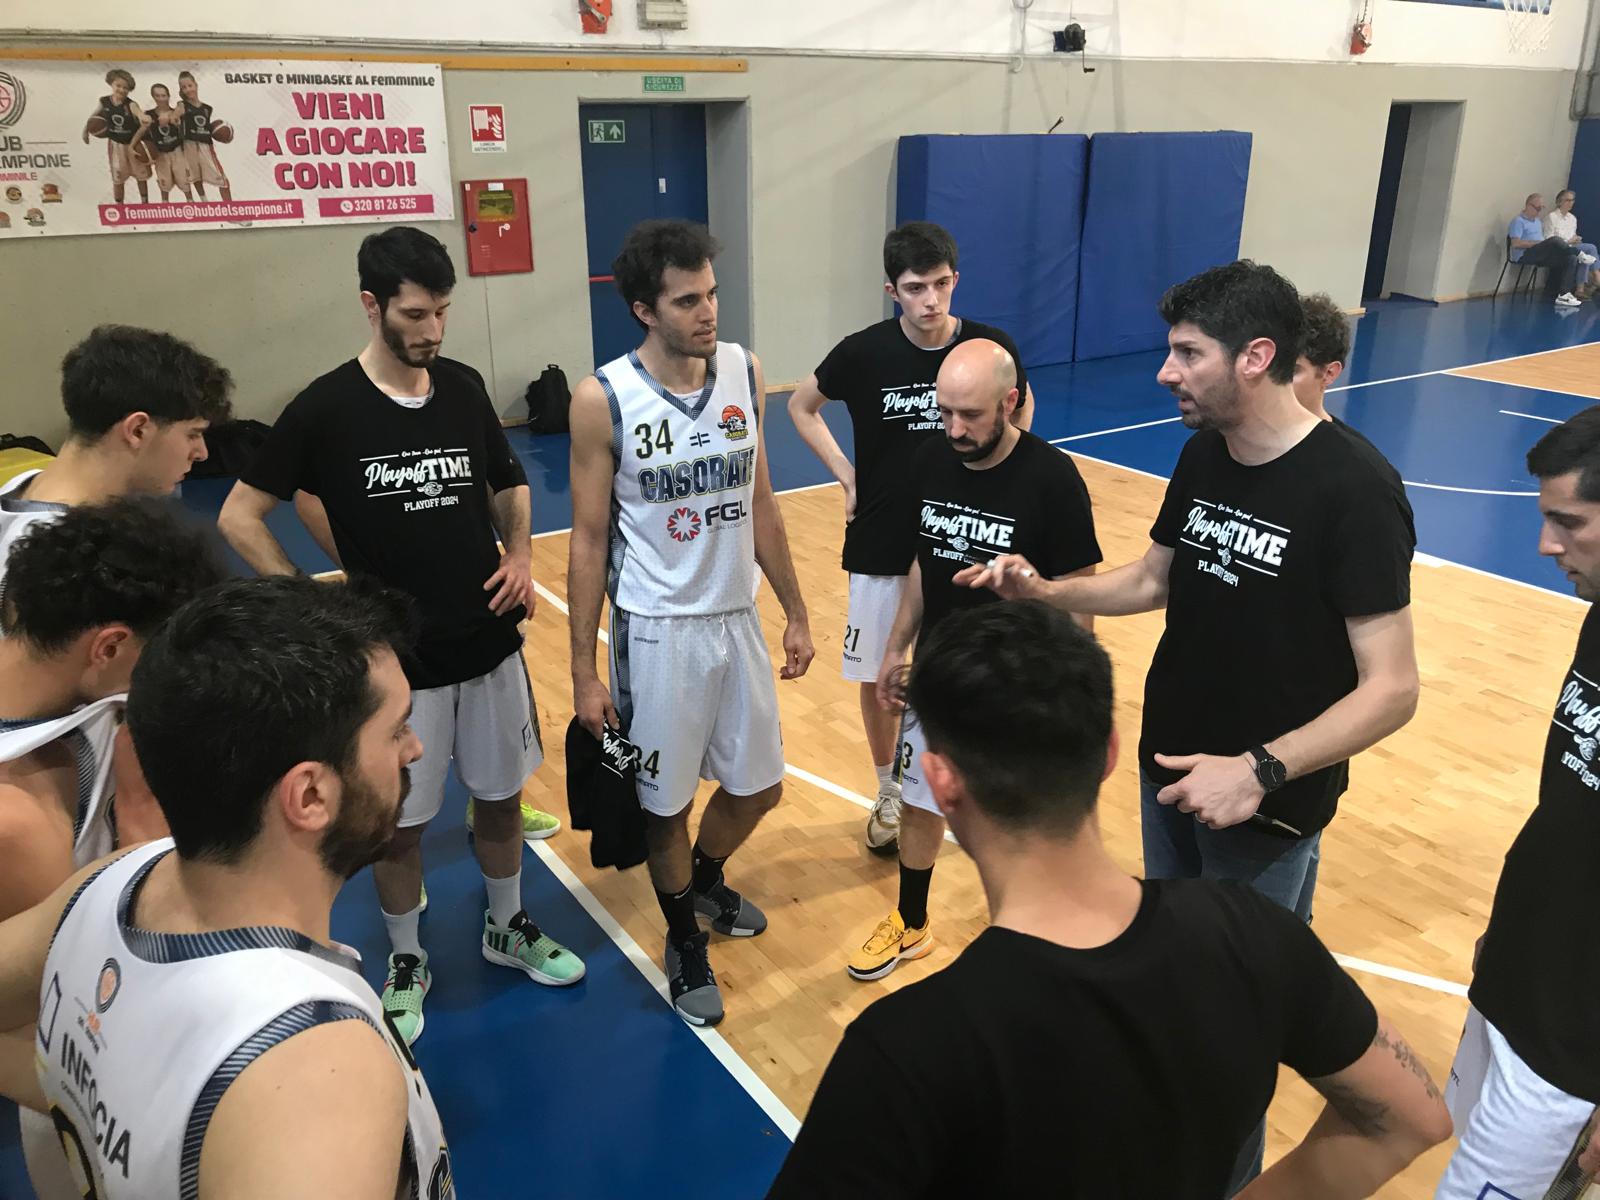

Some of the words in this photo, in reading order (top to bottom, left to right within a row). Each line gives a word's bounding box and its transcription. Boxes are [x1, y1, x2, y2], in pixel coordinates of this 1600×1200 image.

[224, 73, 273, 84] BASKET
[355, 75, 369, 85] AL
[292, 92, 385, 120] VIENI
[256, 128, 283, 156] A
[285, 127, 426, 156] GIOCARE
[0, 154, 72, 169] MPIONE
[274, 162, 344, 190] CON
[348, 161, 417, 189] NOI!
[124, 202, 294, 220] femminile@hubdelsempione.it
[354, 200, 372, 212] 320
[387, 199, 398, 210] 26
[399, 198, 417, 209] 525
[634, 418, 674, 460] 34
[403, 498, 440, 512] PLAYOFF
[440, 495, 459, 506] 2024
[704, 500, 747, 526] FGL
[843, 624, 861, 652] 21
